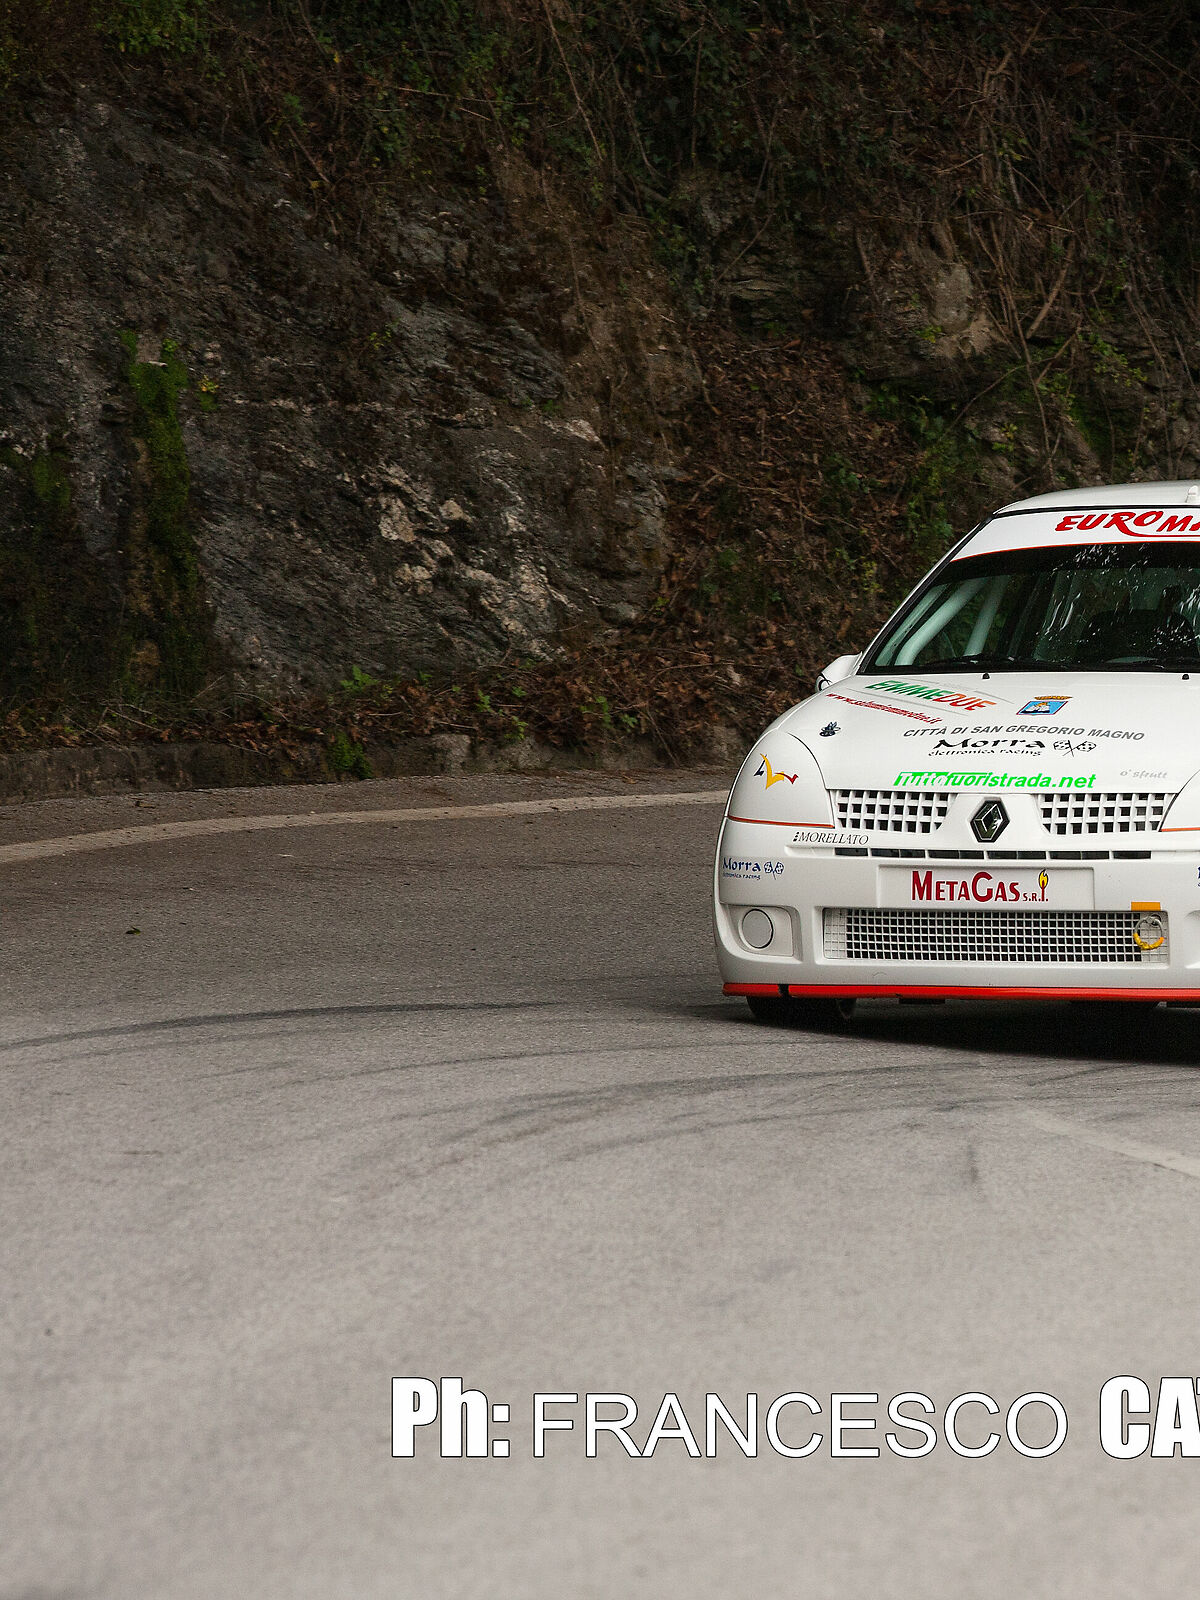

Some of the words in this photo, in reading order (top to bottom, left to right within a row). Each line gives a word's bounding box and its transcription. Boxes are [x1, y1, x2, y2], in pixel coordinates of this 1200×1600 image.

[865, 680, 997, 711] EMMEDUE
[903, 725, 946, 737] CITTÀ
[951, 726, 968, 735] DI
[970, 725, 1003, 735] SAN
[1005, 725, 1085, 736] GREGORIO
[1087, 728, 1145, 741] MAGNO
[932, 738, 1046, 750] Morra
[999, 749, 1043, 757] racing
[799, 832, 869, 845] MORELLATO
[722, 857, 761, 872] Morra
